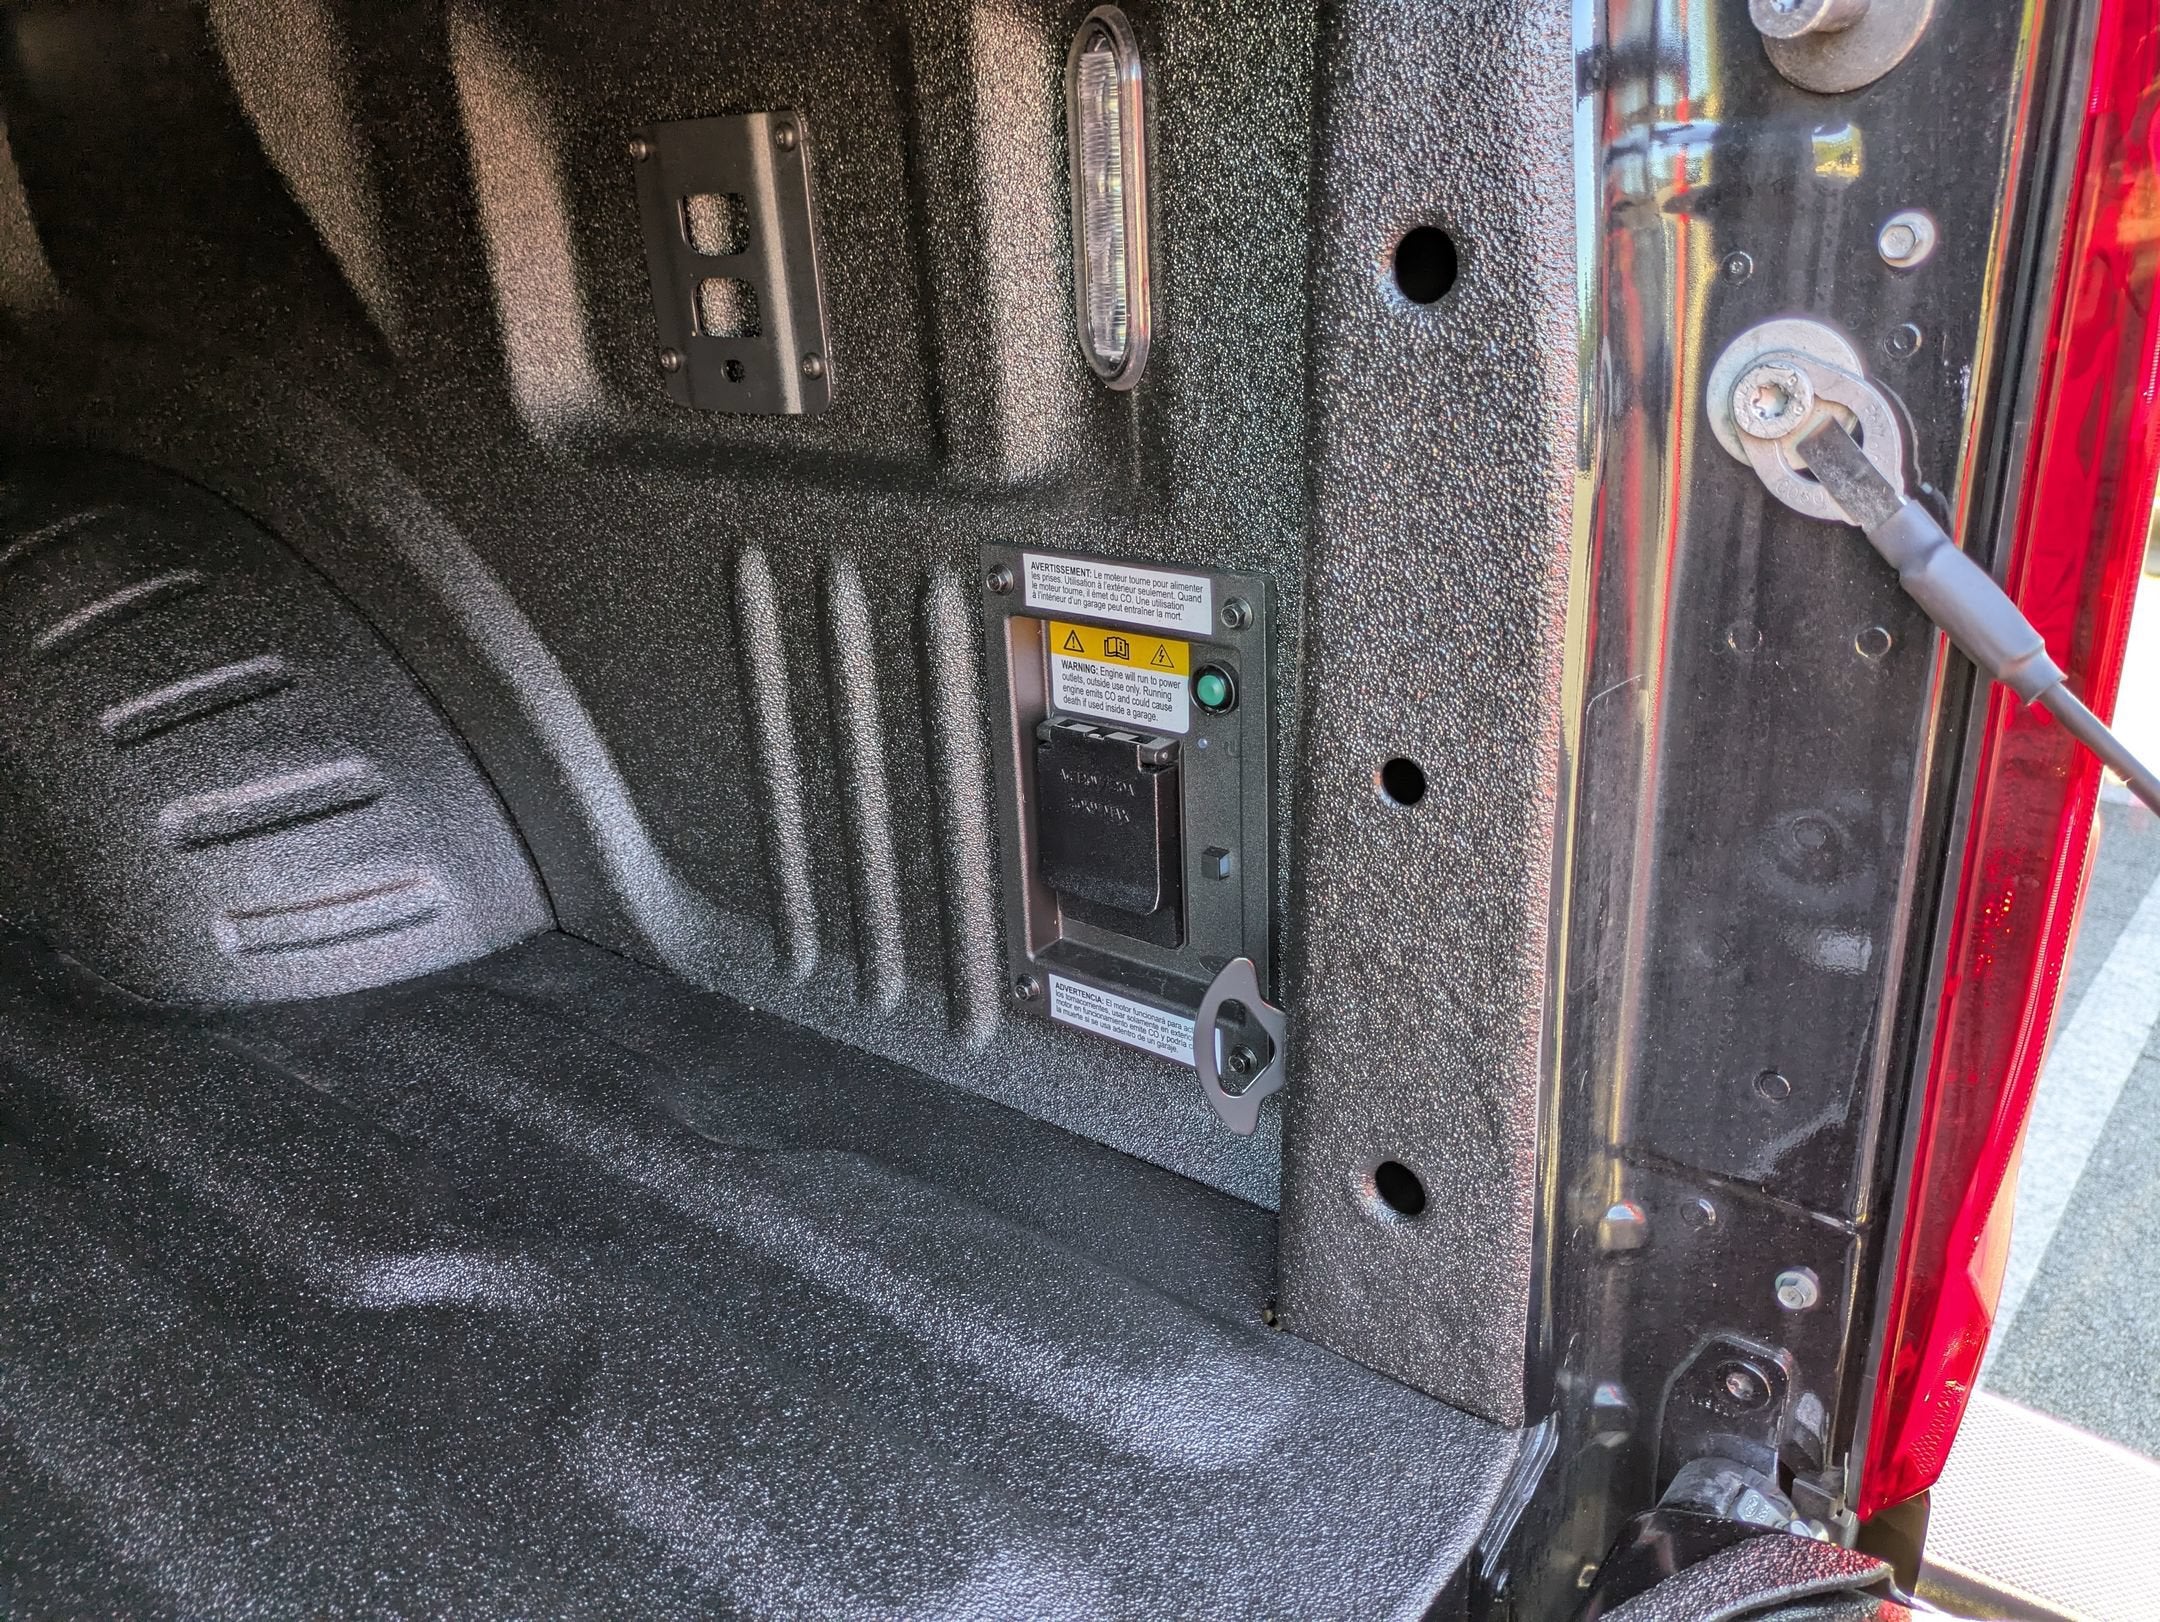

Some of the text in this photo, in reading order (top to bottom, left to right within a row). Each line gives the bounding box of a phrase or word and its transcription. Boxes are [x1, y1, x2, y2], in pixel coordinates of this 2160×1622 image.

[1030, 562, 1203, 592] AVERTISSEMENT: Le moteur tourne pour alimenter
[1031, 571, 1040, 580] les
[1042, 573, 1062, 584] prises.
[1065, 576, 1095, 588] Utilisation
[1103, 581, 1136, 594] l'extérieur
[1138, 587, 1175, 599] seulement.
[1178, 592, 1202, 603] Quand
[1032, 580, 1037, 589] le
[1039, 583, 1060, 592] moteur
[1062, 586, 1085, 597] tourne,
[1086, 589, 1090, 597] il
[1091, 590, 1108, 599] émet
[1109, 592, 1118, 601] du
[1135, 596, 1150, 606] Une
[1152, 600, 1184, 611] utilisation
[1032, 591, 1036, 599] à
[1068, 596, 1081, 606] d'un
[1083, 600, 1106, 610] garage
[1108, 603, 1122, 612] peut
[1124, 605, 1155, 616] entraîner
[1157, 608, 1163, 617] la
[1164, 611, 1183, 620] mort.
[1061, 660, 1181, 689] WARNING: Engine will run to power
[1062, 673, 1172, 702] outlets, outside use only. Running
[1063, 685, 1172, 712] engine emits CO and could cause
[1063, 695, 1159, 722] death if used inside a garage.
[1056, 982, 1104, 1004] ADVERTENCIA:
[1106, 998, 1112, 1007] El
[1114, 1002, 1132, 1012] motor
[1133, 1008, 1165, 1024] funcionará
[1167, 1020, 1182, 1030] para
[1056, 990, 1064, 998] los
[1112, 1010, 1125, 1018] usar
[1127, 1015, 1159, 1030] solamente
[1171, 1029, 1193, 1041] exterio
[1056, 999, 1072, 1008] motor
[1083, 1007, 1128, 1028] funcionamiento
[1130, 1024, 1147, 1034] emite
[1148, 1029, 1159, 1038] CO
[1167, 1036, 1187, 1048] podría
[1056, 1005, 1061, 1013] la
[1063, 1009, 1083, 1021] muerte
[1100, 1021, 1111, 1030] usa
[1112, 1026, 1136, 1038] adentro
[1157, 1040, 1179, 1053] garaje.
